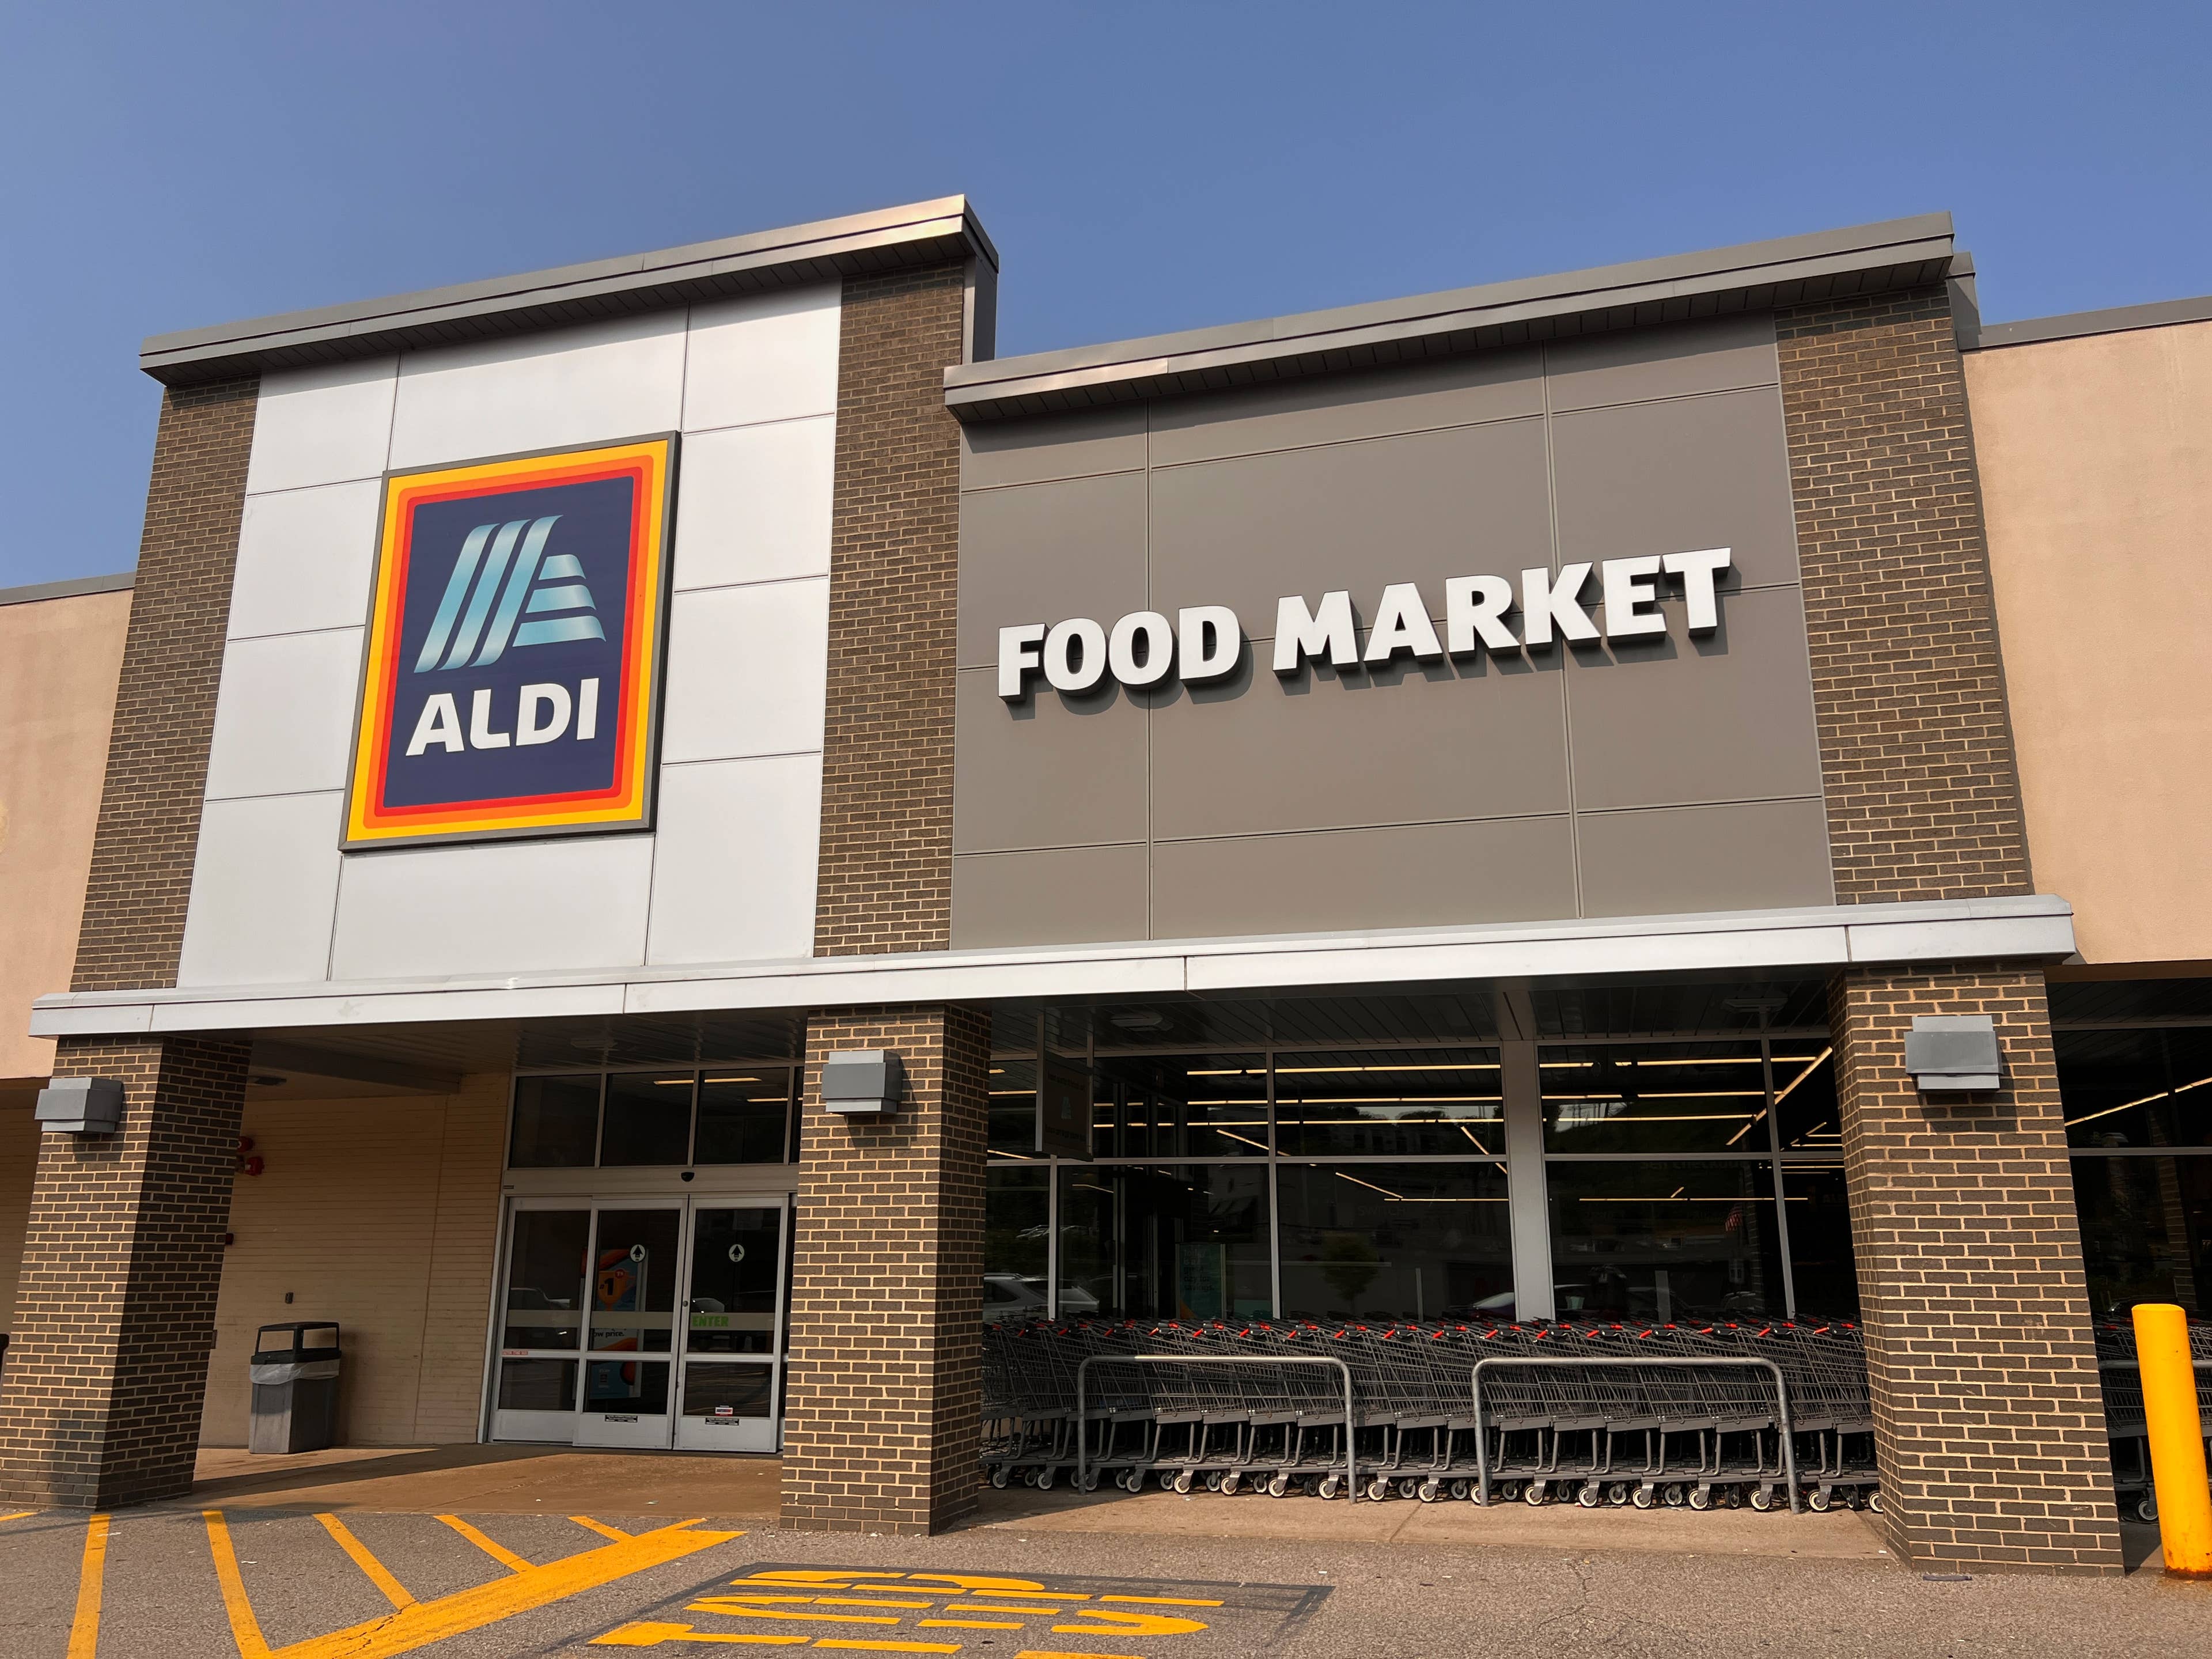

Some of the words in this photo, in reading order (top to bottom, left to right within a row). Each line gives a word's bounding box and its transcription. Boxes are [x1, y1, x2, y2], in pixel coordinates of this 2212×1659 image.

[998, 605, 1241, 700] FOOD
[1272, 547, 1732, 676] MARKET
[405, 677, 600, 756] ALDI
[692, 1316, 729, 1327] ENTER
